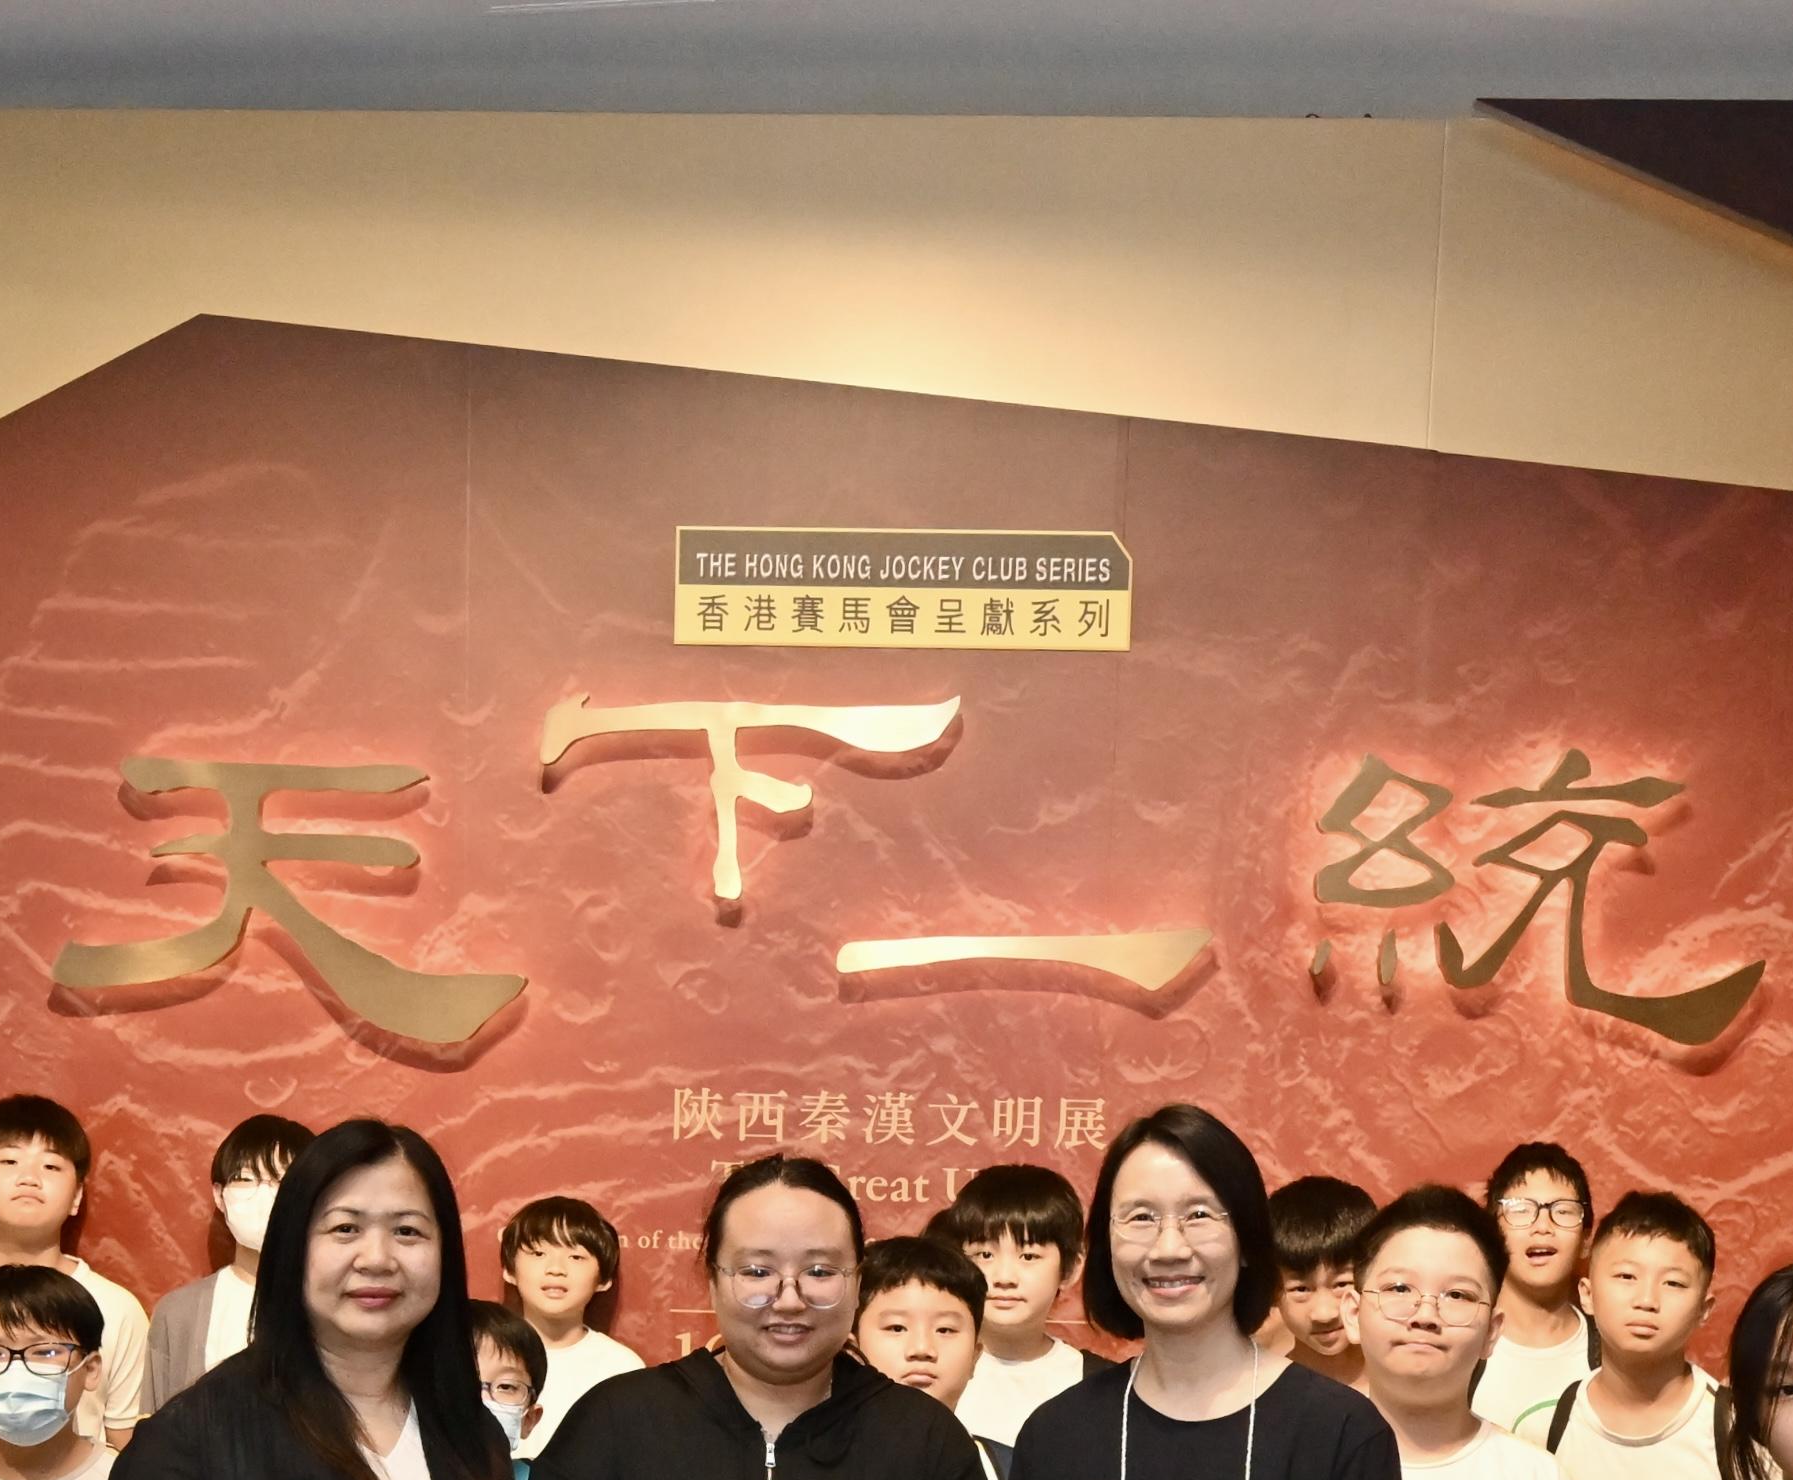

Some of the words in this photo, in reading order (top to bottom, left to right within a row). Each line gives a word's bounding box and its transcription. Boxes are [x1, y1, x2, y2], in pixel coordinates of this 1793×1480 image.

[697, 552, 737, 578] THE
[745, 553, 804, 579] HONG
[812, 554, 872, 580] KONG
[880, 555, 965, 582] JOCKEY
[972, 556, 1028, 582] CLUB
[1036, 557, 1112, 583] SERIES
[696, 595, 1111, 638] 香港賽馬會呈獻系列
[51, 693, 1766, 1049] 天下一統
[672, 1087, 1108, 1150] 陝西秦漢文明展
[825, 1164, 930, 1203] reat
[638, 1229, 663, 1249] of
